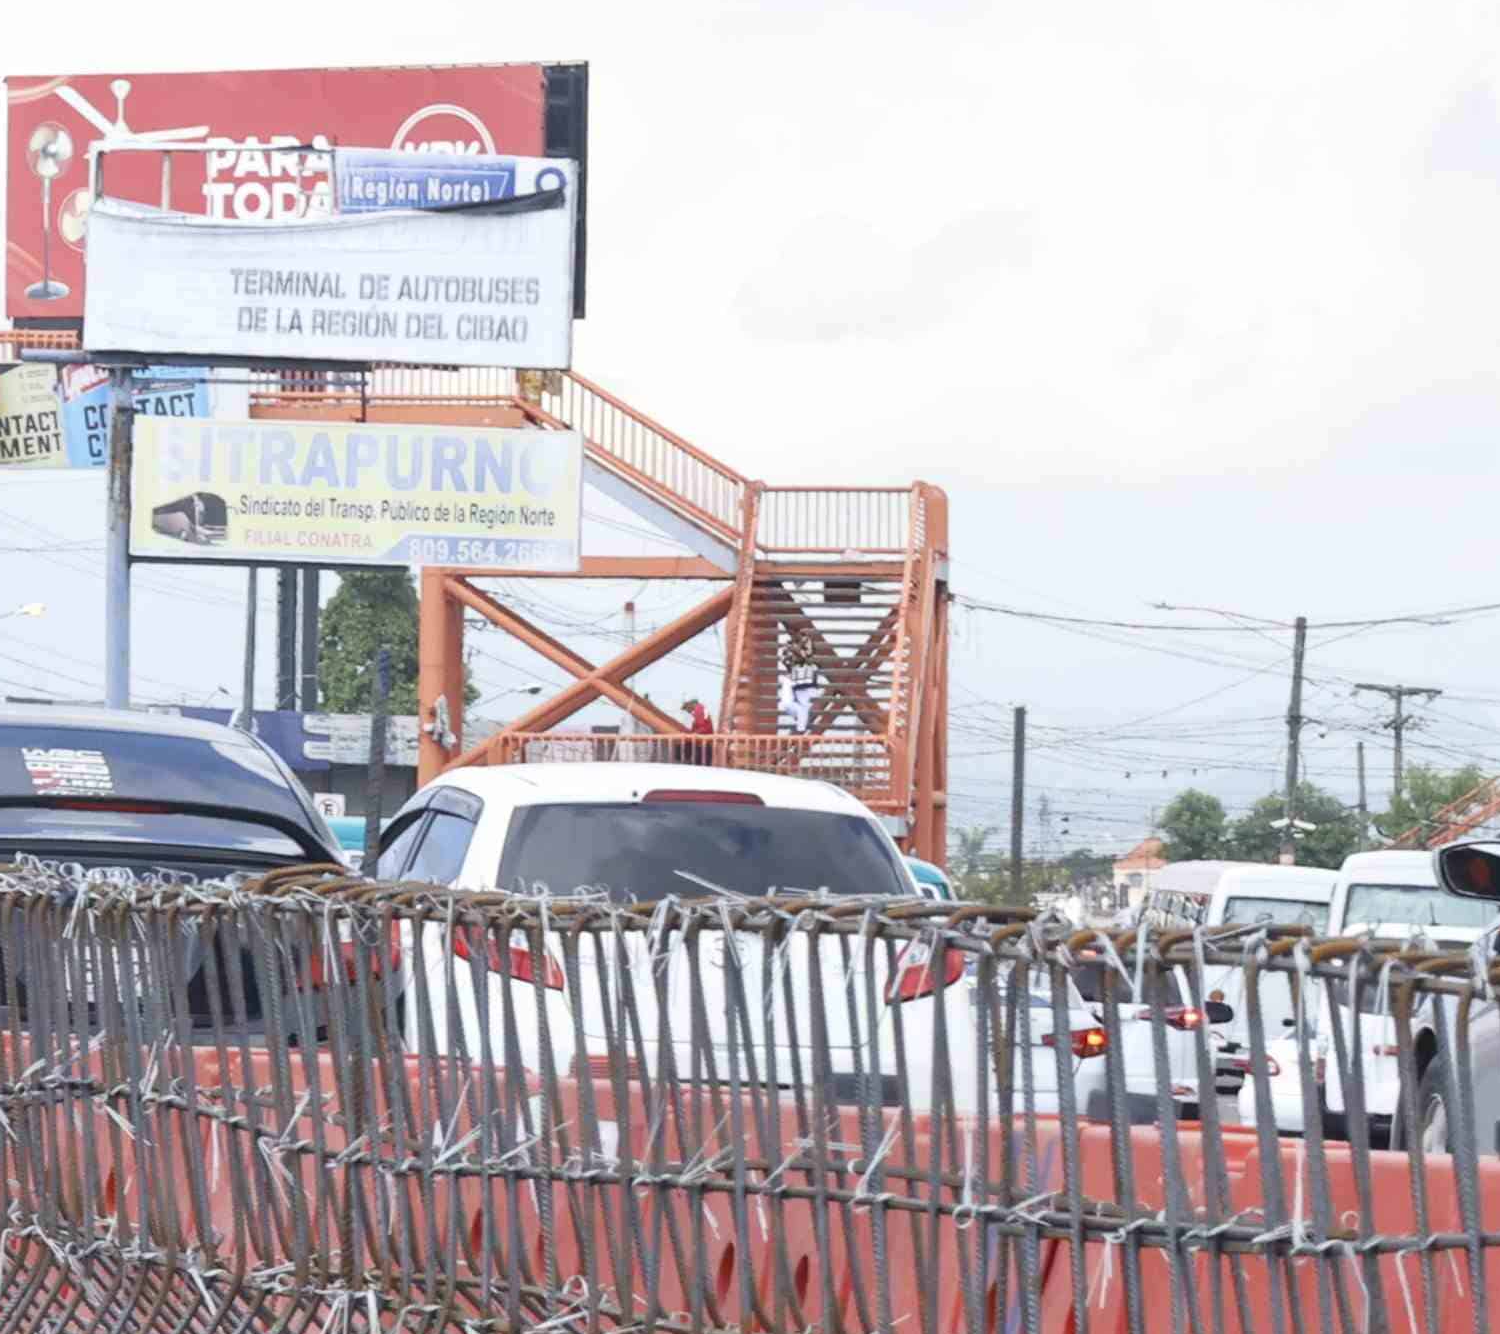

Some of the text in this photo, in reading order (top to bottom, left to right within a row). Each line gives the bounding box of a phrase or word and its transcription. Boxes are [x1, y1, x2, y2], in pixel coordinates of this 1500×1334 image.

[207, 135, 332, 178] PARA
[230, 268, 541, 306] TERMINAL DE AUTOBUSES
[236, 306, 529, 343] DE LA REGIÓN DEL CIBAO
[239, 494, 555, 529] Sindicato del Transp. Público de la Región Norte
[245, 531, 374, 549] FILIAL CONATRA
